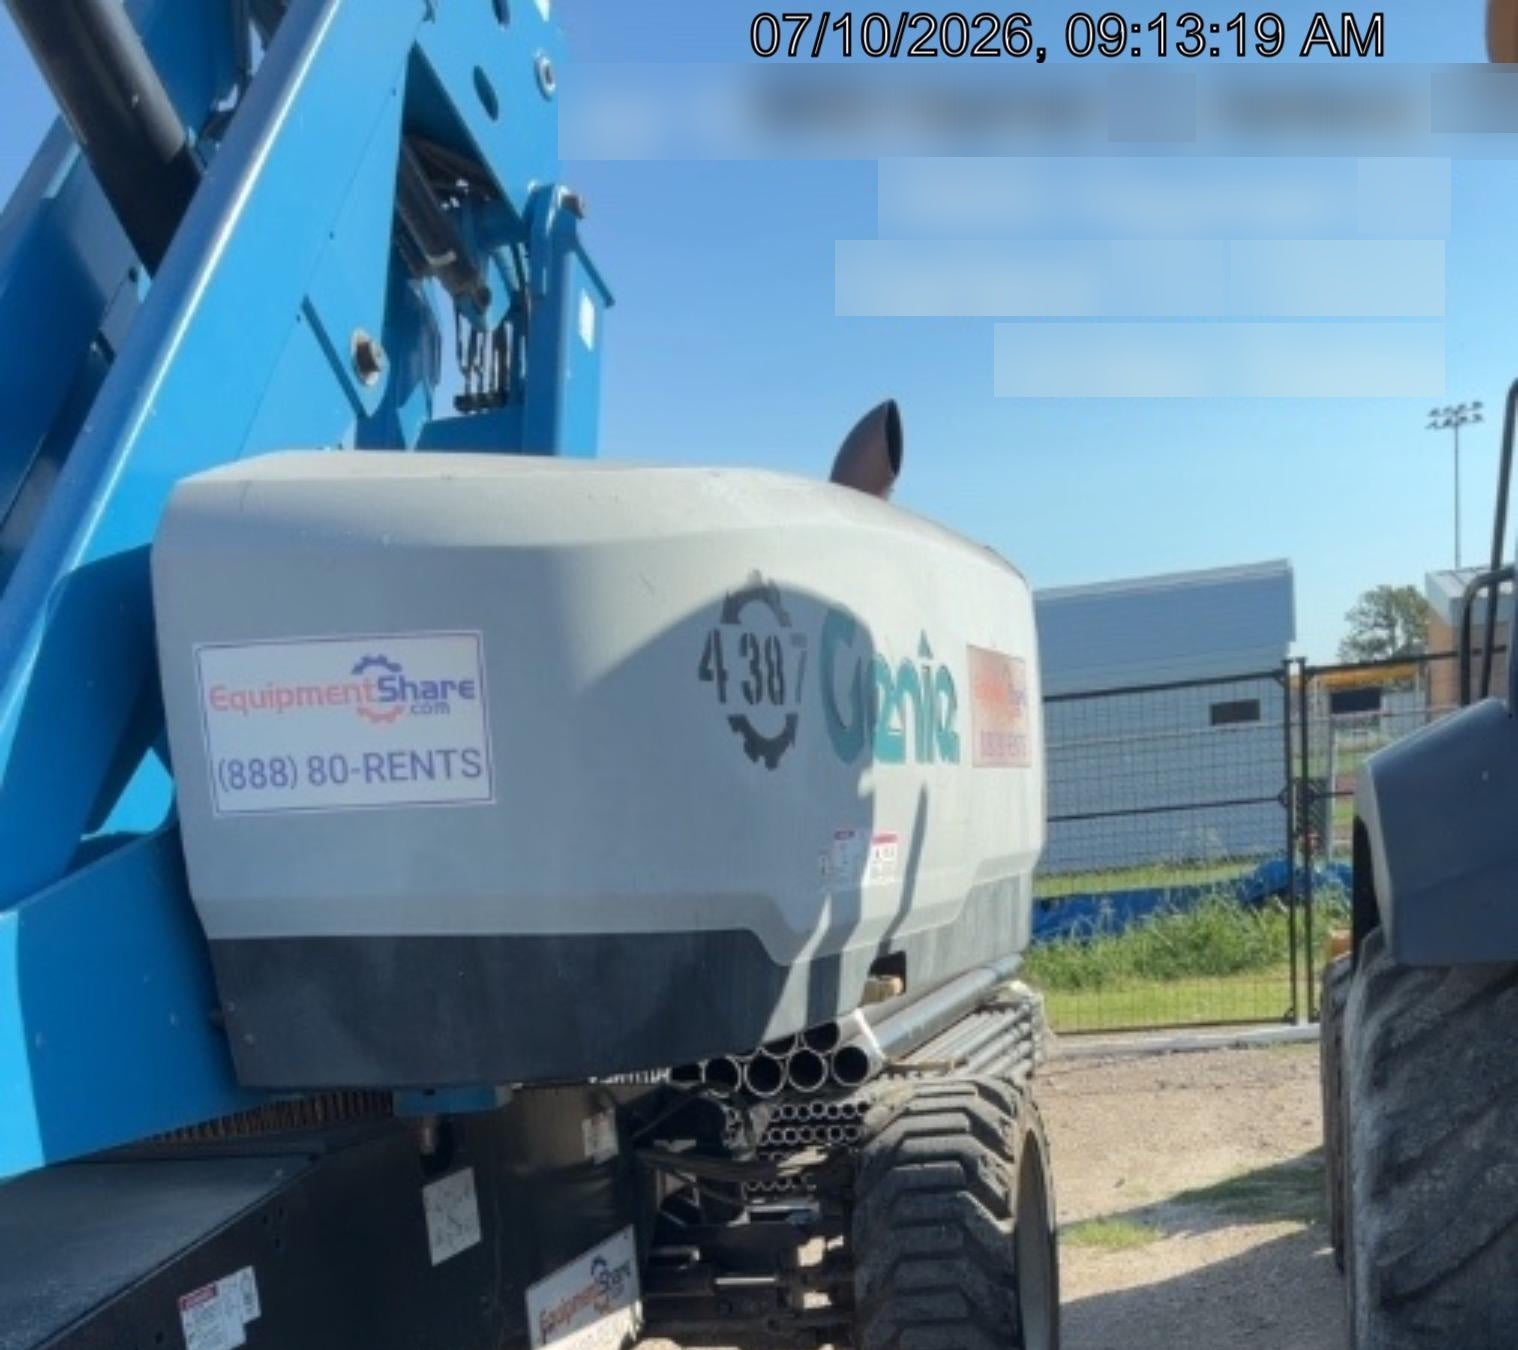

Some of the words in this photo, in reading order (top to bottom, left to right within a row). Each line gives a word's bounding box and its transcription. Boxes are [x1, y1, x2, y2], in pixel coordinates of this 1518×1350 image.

[819, 606, 961, 766] Genie
[218, 755, 298, 793] (888)
[307, 748, 483, 787] 80-RENTS
